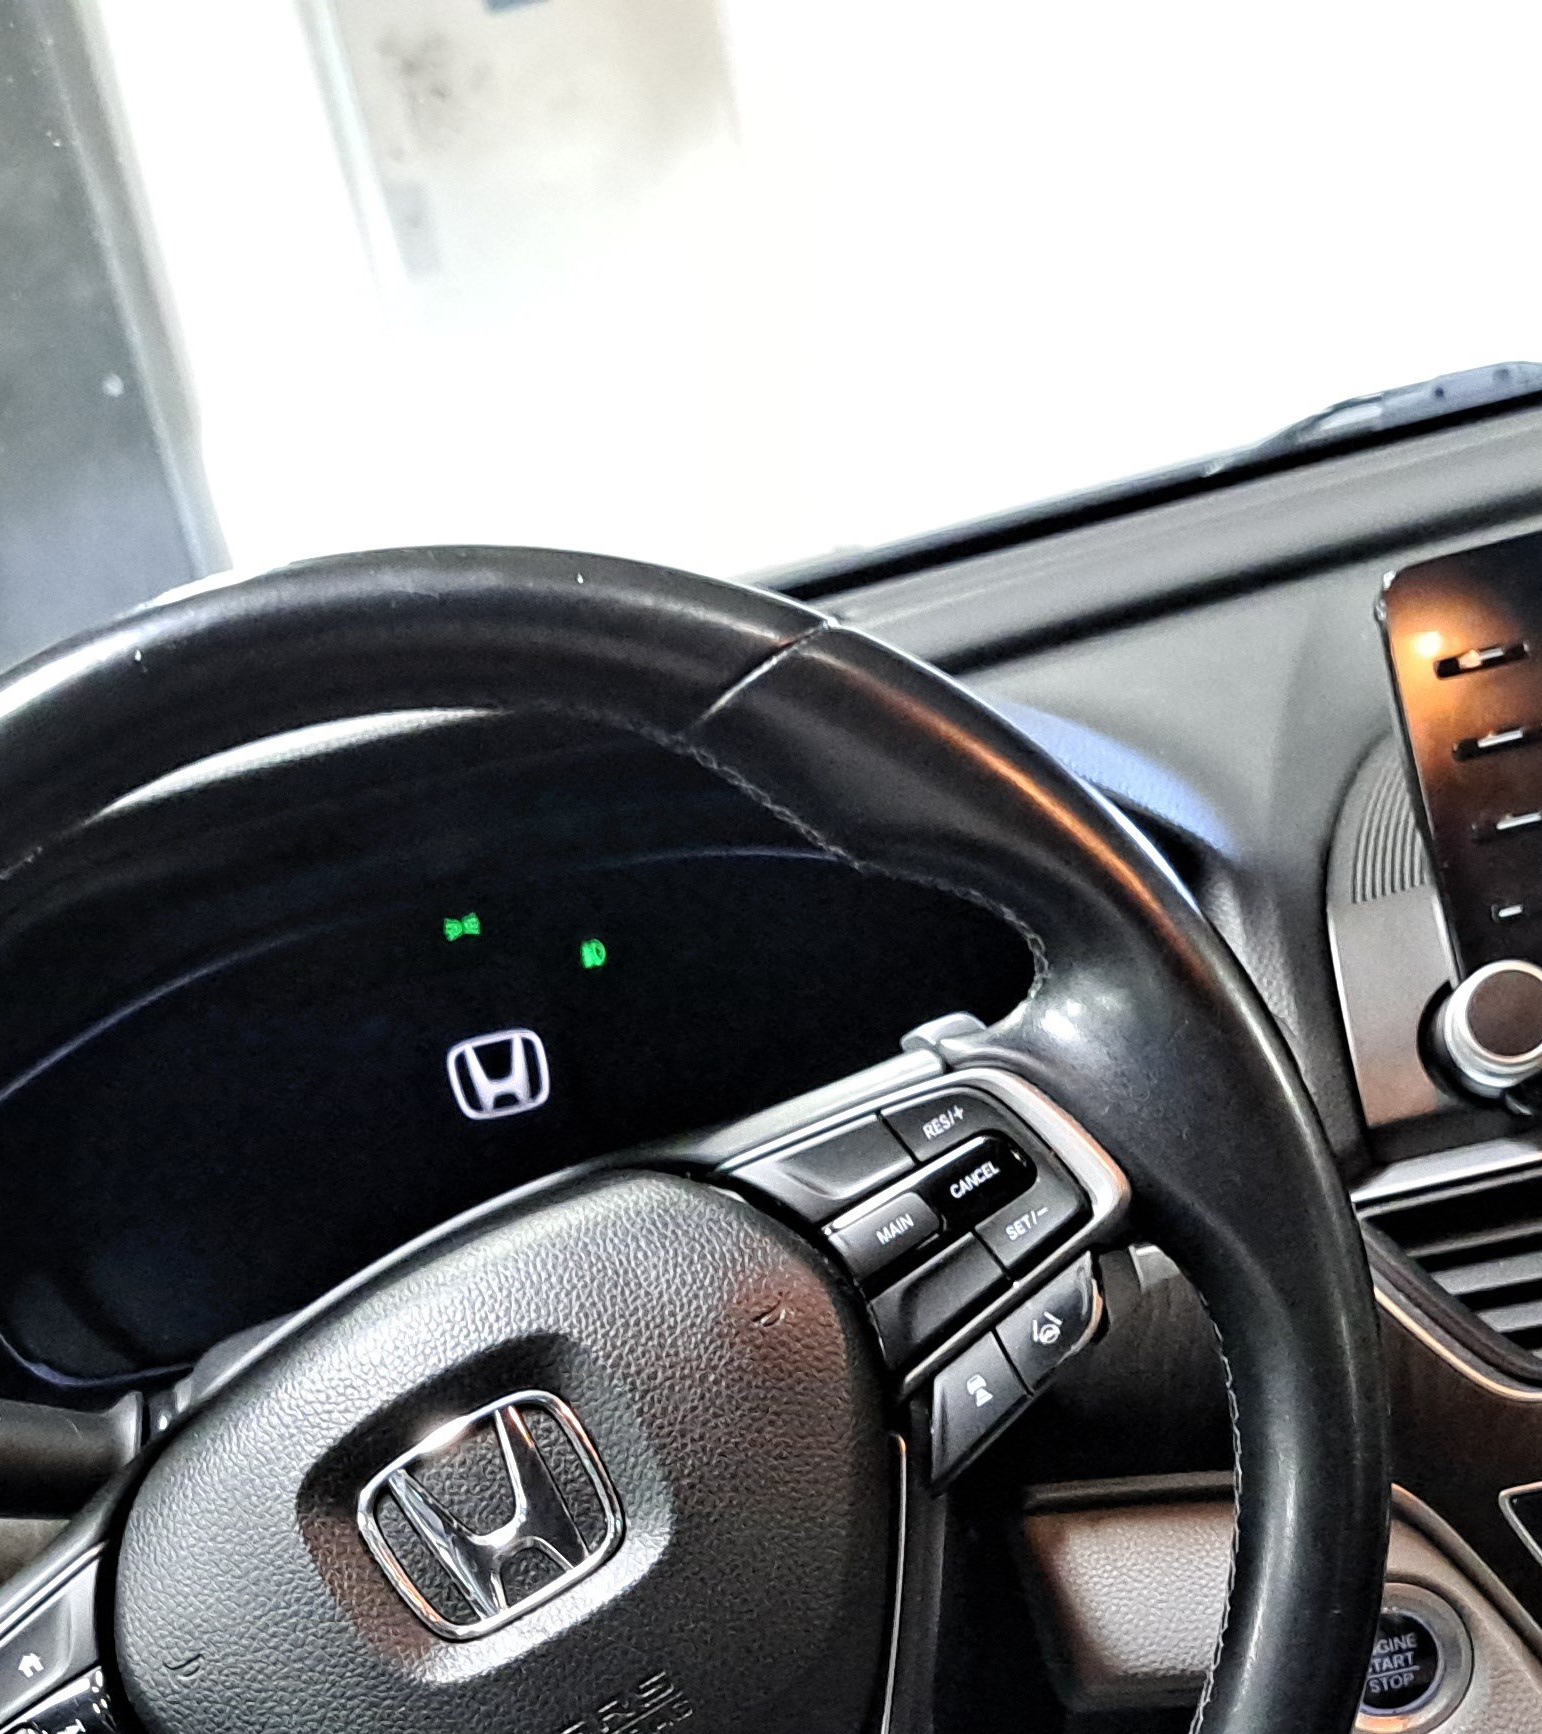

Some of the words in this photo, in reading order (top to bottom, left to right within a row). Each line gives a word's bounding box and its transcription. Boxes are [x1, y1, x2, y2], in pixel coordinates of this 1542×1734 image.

[949, 1160, 1001, 1199] CANCEL
[875, 1212, 915, 1245] MAIN
[1373, 1631, 1418, 1656] GINE
[1368, 1651, 1415, 1673] TART
[1368, 1672, 1415, 1694] STOP
